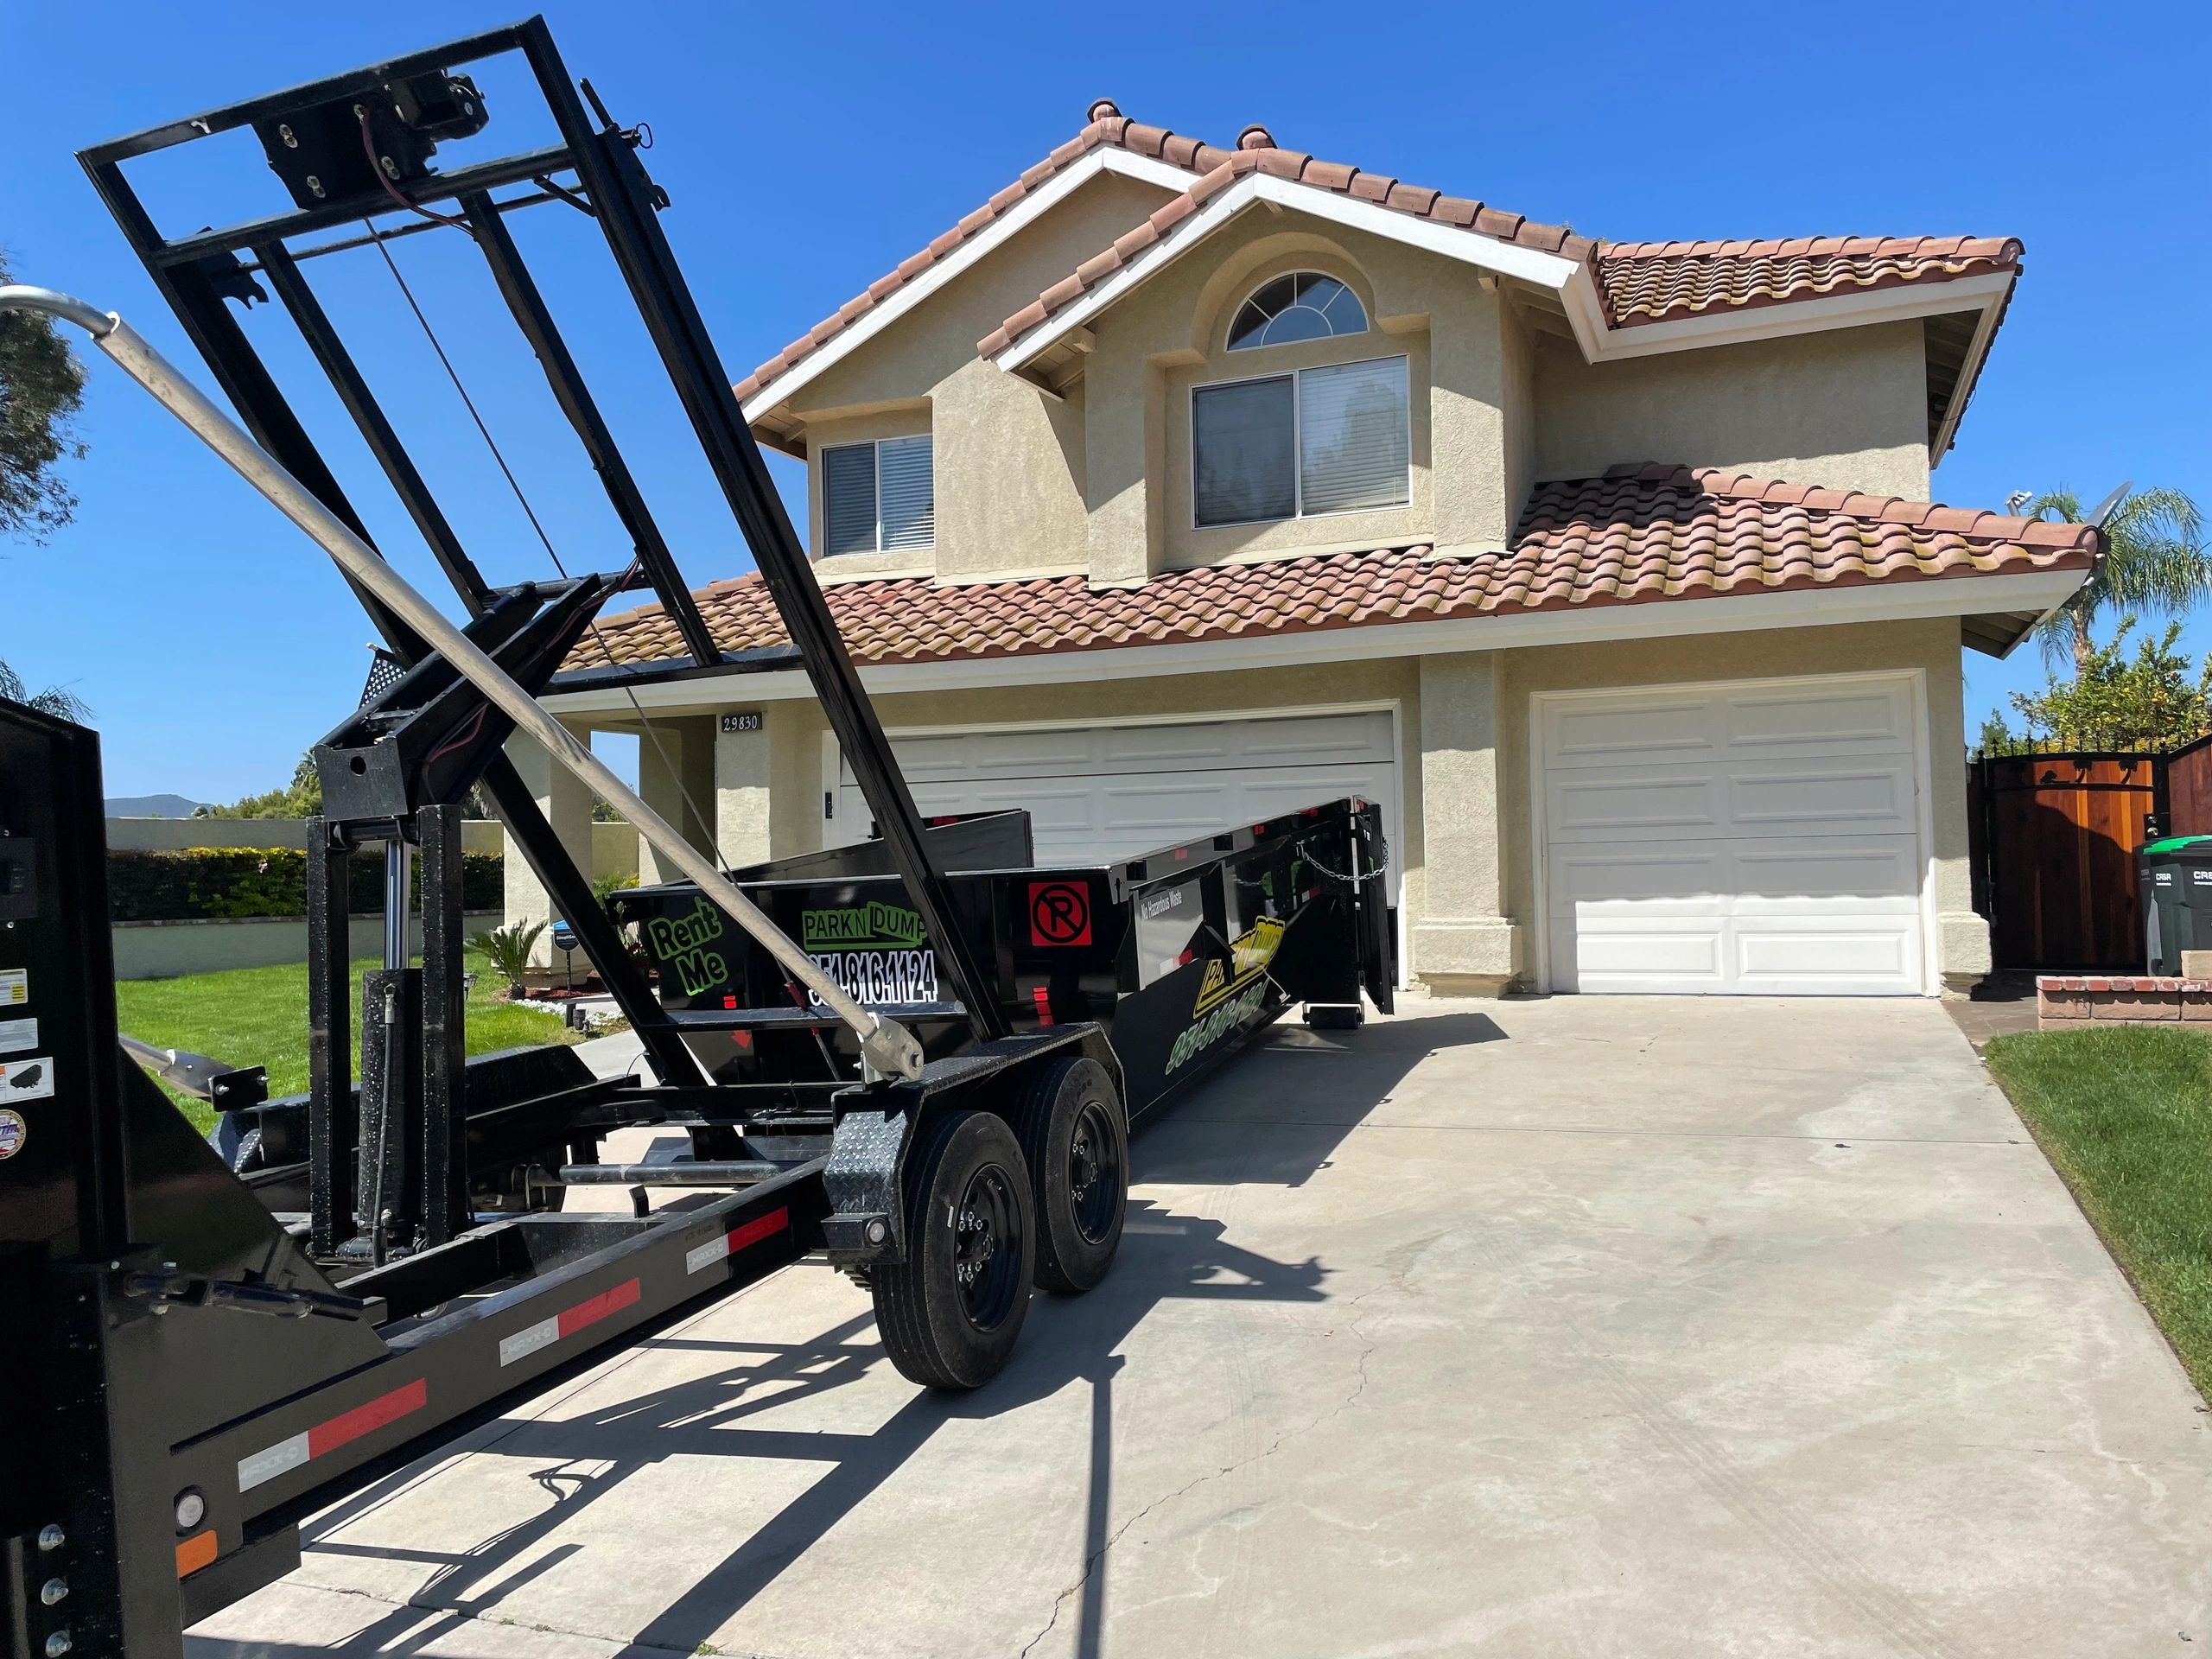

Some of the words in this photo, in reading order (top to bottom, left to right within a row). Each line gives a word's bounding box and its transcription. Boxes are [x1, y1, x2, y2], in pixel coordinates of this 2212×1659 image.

[724, 715, 758, 731] 29830
[1141, 903, 1148, 920] No
[1147, 895, 1170, 918] Hazardous
[1168, 889, 1182, 908] Waste
[648, 896, 722, 960] Rent
[675, 948, 728, 996] Me
